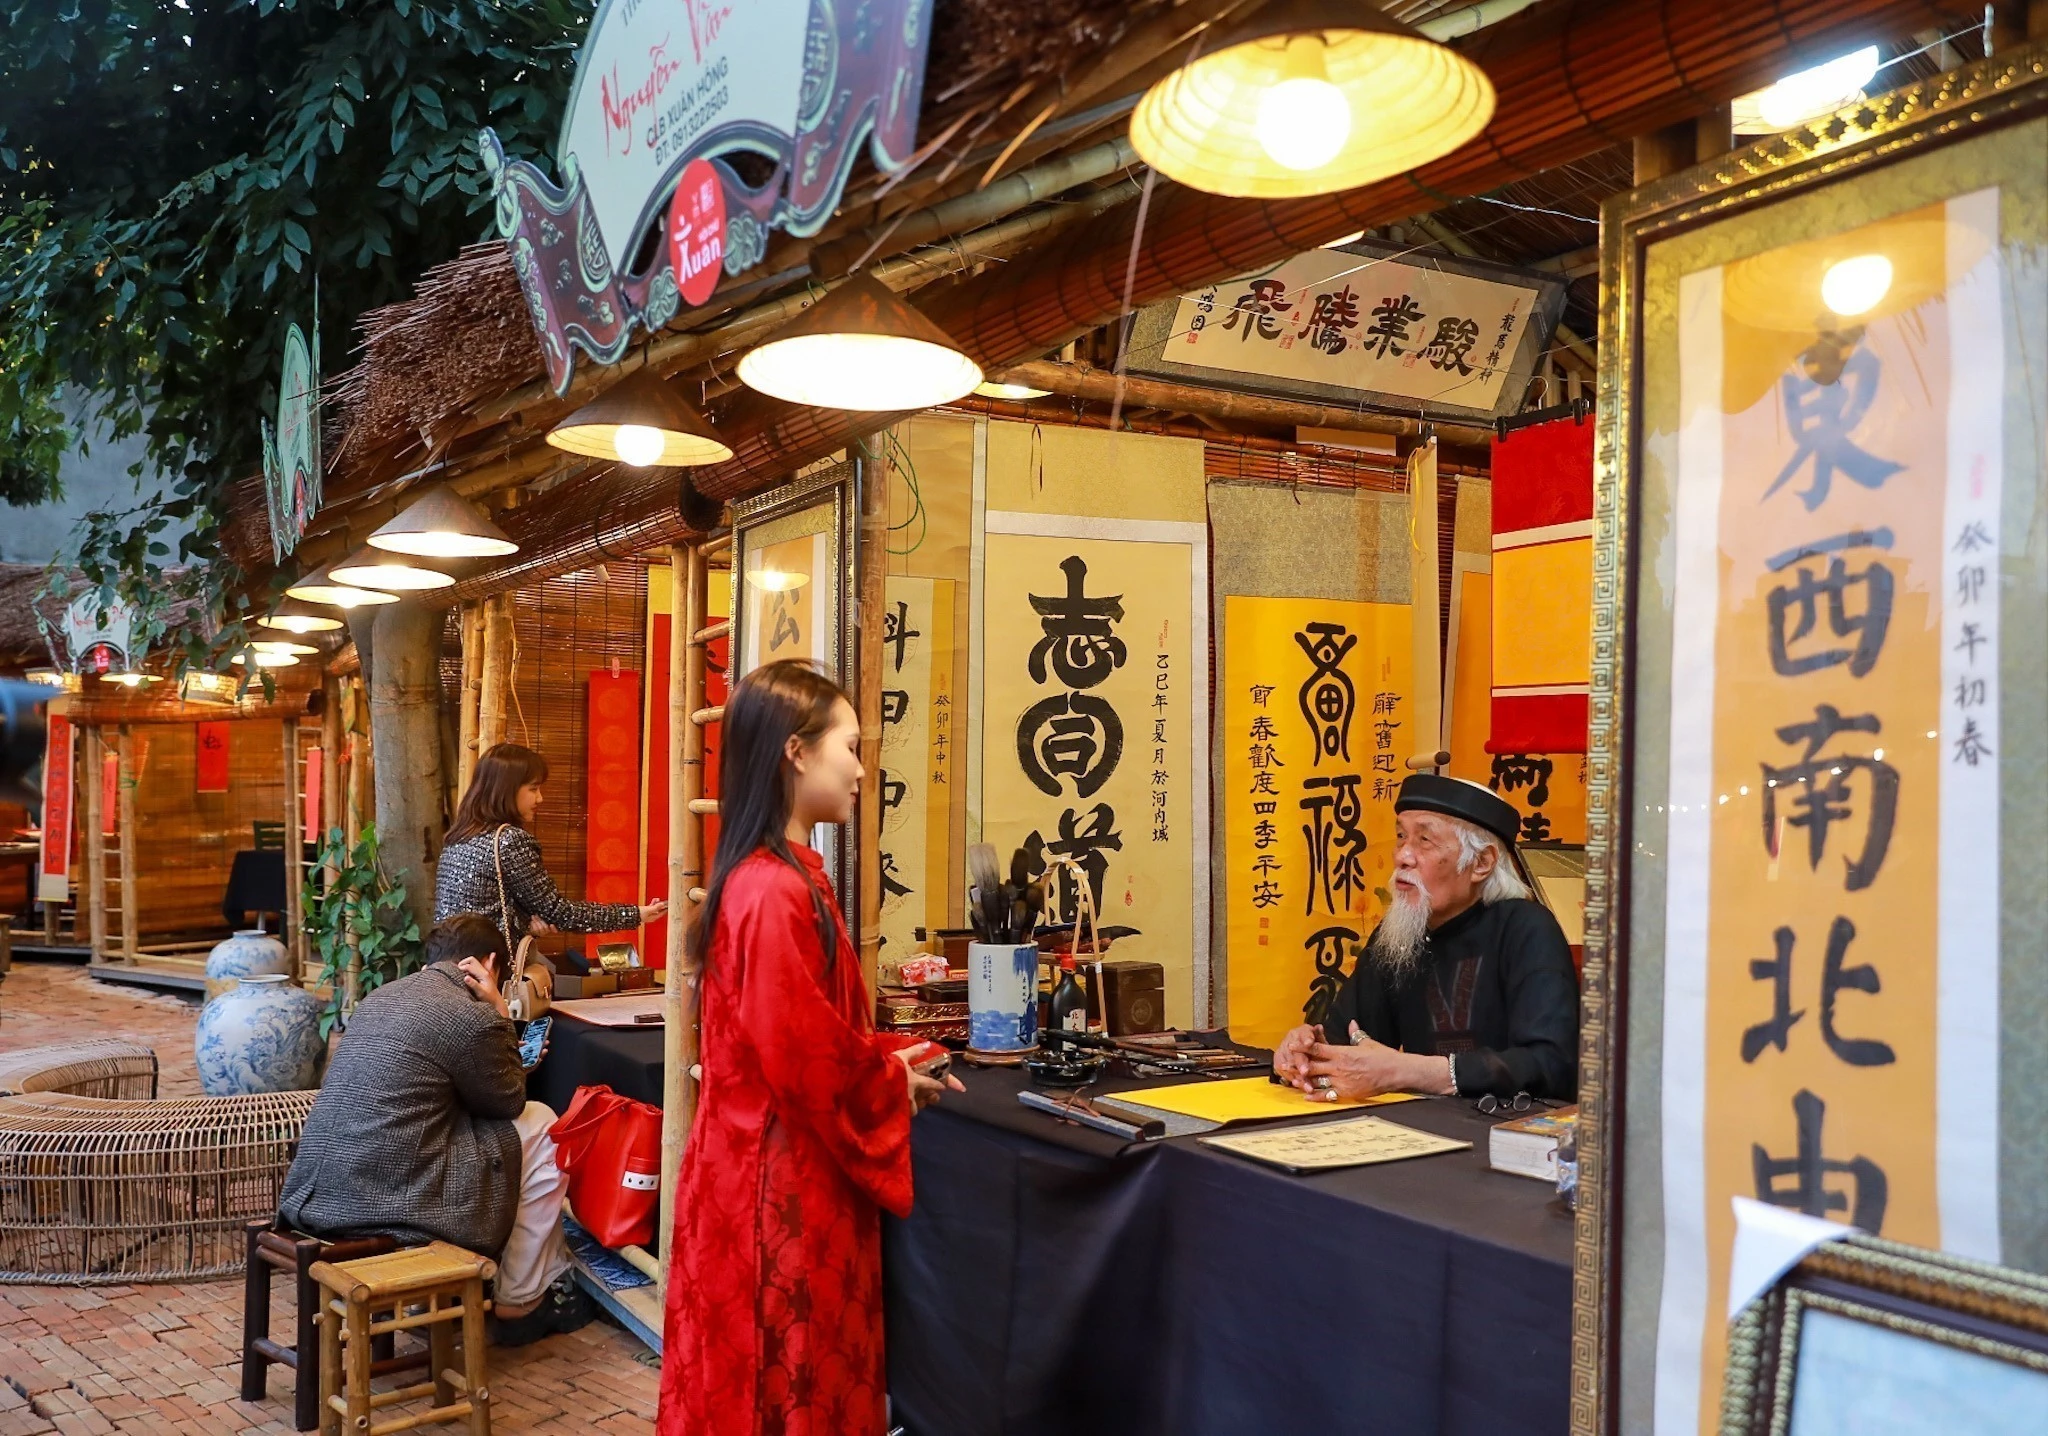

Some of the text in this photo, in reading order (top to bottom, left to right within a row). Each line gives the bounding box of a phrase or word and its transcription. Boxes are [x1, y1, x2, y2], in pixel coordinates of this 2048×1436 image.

[646, 115, 666, 147] CLB
[667, 88, 695, 126] XUÂN
[932, 694, 951, 784] 癸卯年中秋
